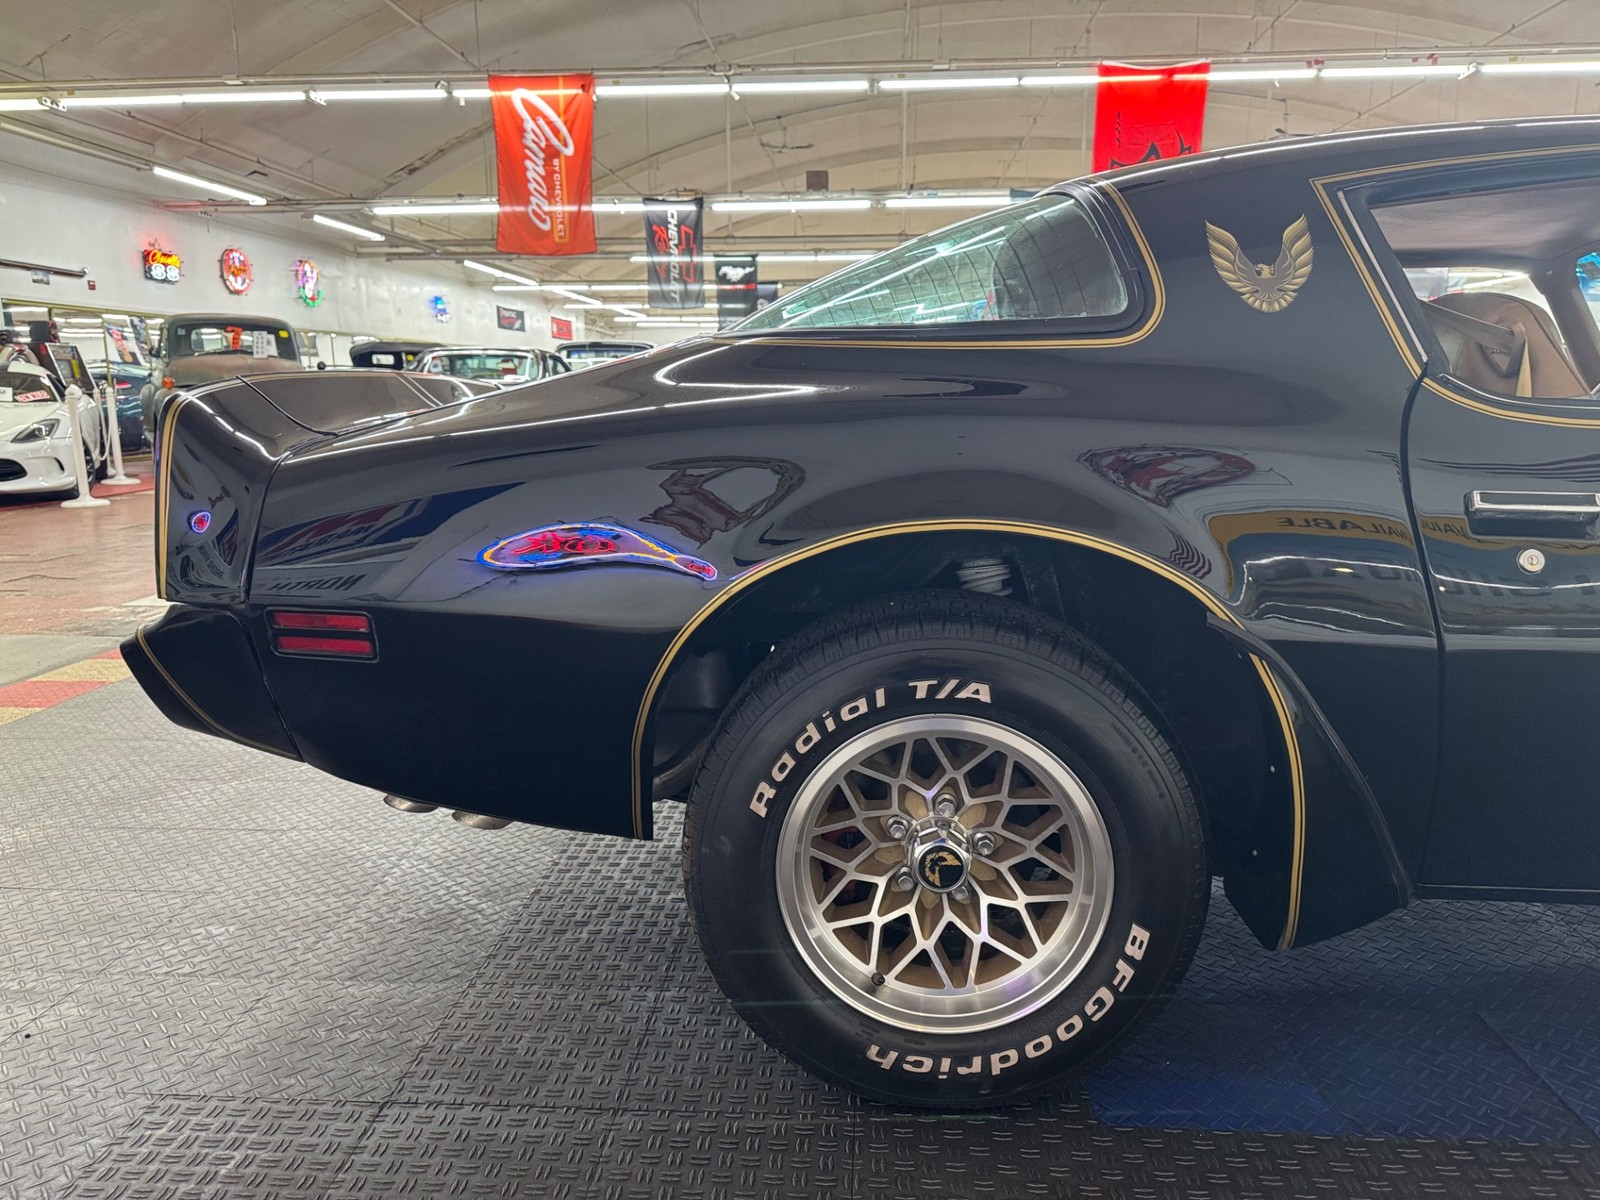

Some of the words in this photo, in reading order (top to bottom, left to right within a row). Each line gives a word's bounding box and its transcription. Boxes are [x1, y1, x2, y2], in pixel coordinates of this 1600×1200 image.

[511, 88, 574, 231] Camaro
[552, 158, 560, 172] BY
[151, 264, 180, 281] SS
[749, 687, 886, 818] Radial
[908, 679, 992, 703] T/A
[865, 922, 1151, 1080] BFGoodrich
